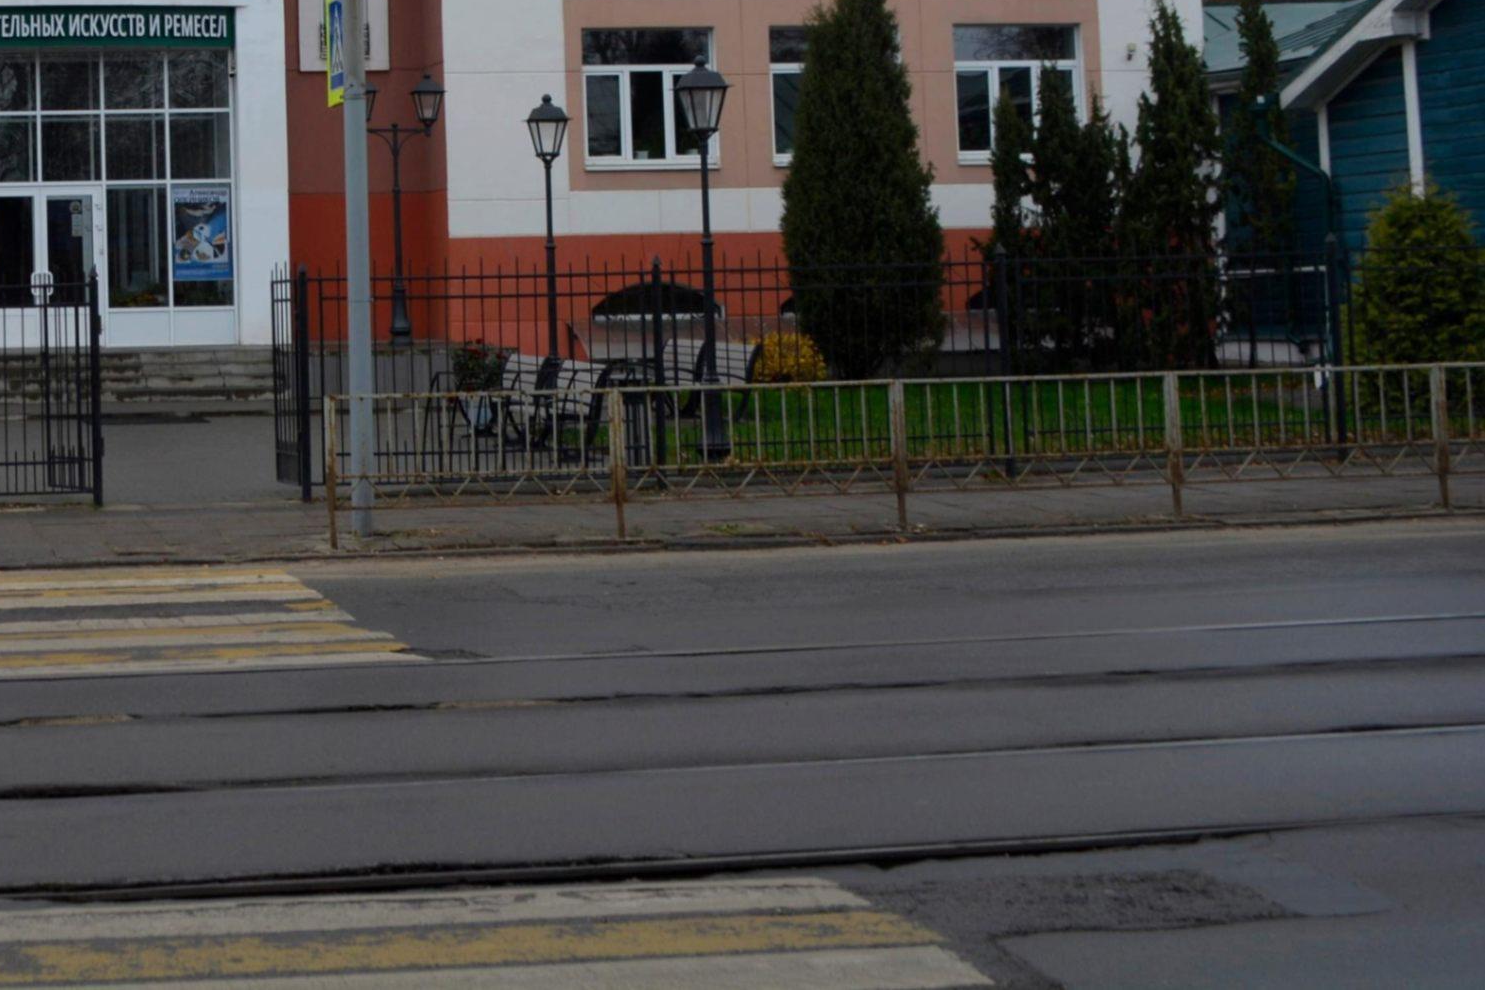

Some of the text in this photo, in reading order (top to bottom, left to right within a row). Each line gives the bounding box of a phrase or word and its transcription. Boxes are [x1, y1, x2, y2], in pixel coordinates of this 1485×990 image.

[68, 13, 145, 37] ИСКУССТВ
[149, 14, 161, 37] И
[164, 14, 227, 38] РЕМЕСЕЛ
